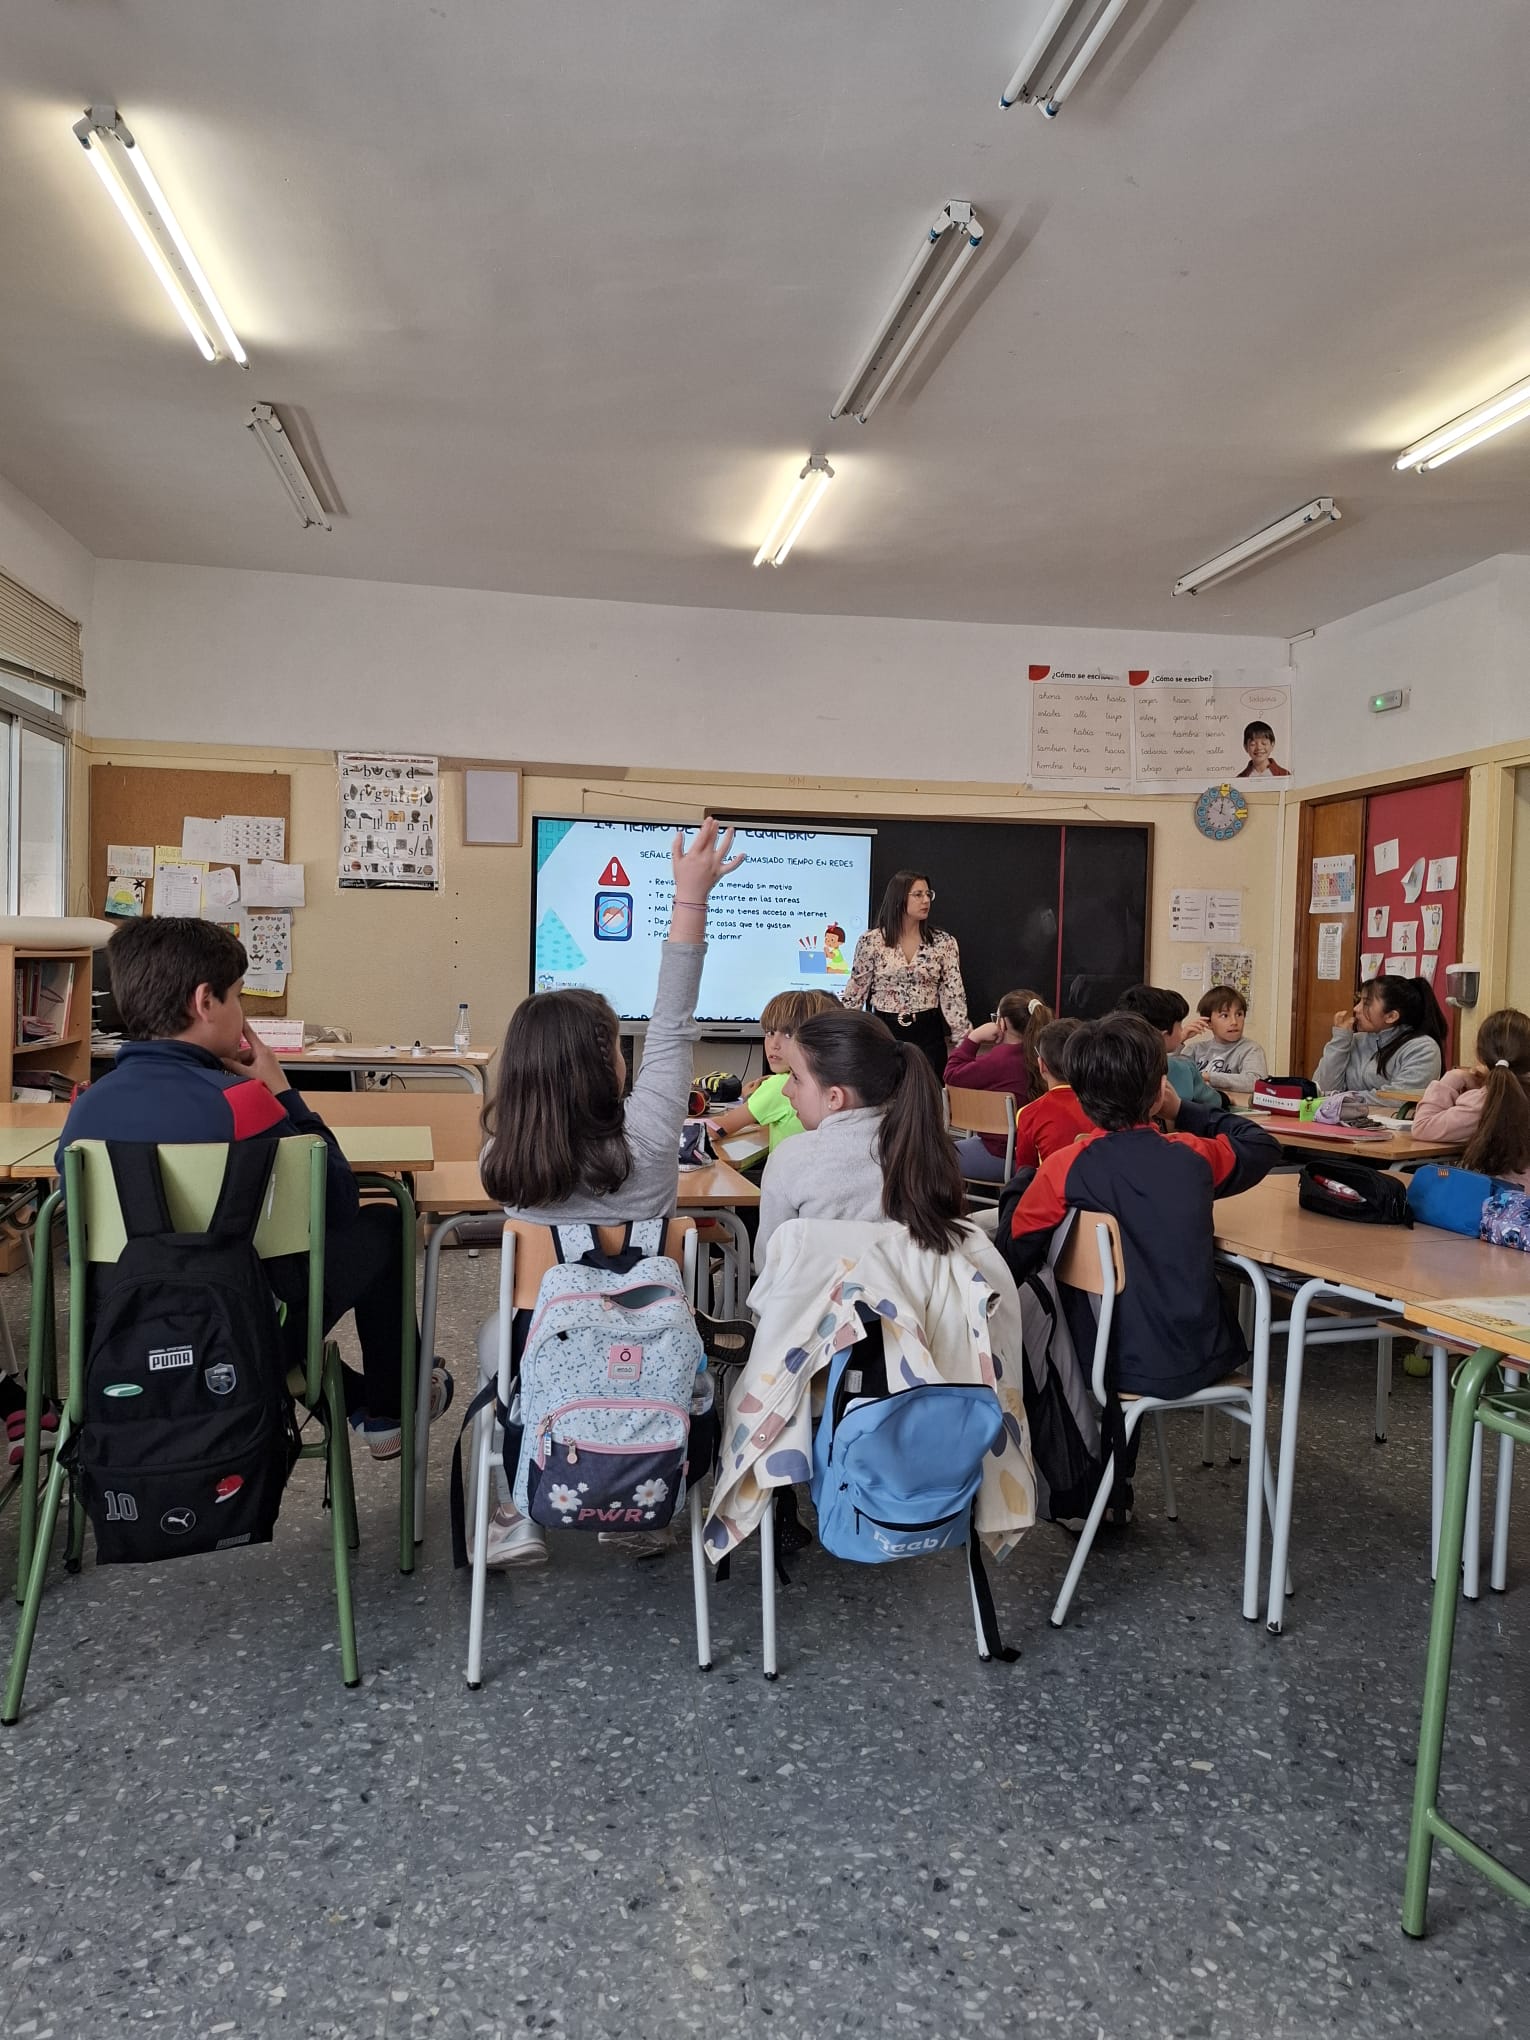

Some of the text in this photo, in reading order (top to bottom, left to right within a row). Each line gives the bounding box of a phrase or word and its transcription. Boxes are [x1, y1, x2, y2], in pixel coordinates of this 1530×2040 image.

[1052, 671, 1075, 679] ¿Cómo
[1152, 675, 1173, 683] ¿Cómo
[1183, 674, 1212, 682] escribe?
[342, 764, 414, 779] a b c d
[343, 793, 350, 801] e
[374, 790, 382, 802] g
[343, 816, 351, 829] k
[385, 822, 397, 830] m
[407, 823, 414, 831] n
[422, 820, 429, 832] ñ
[343, 845, 351, 854] o
[361, 846, 367, 857] p
[382, 846, 390, 858] q
[408, 847, 414, 855] s
[640, 850, 674, 860] SEÑALE
[744, 856, 784, 864] EMASIADO
[787, 857, 814, 866] TIEMPO
[816, 859, 827, 867] EN
[829, 860, 854, 868] REDES
[343, 864, 351, 872] u
[364, 864, 371, 872] v
[381, 865, 388, 873] x
[417, 866, 423, 874] z
[655, 878, 677, 886] Revis
[726, 881, 754, 889] menudo
[655, 891, 664, 899] Te
[738, 908, 760, 916] tienes
[797, 910, 828, 918] internet
[717, 932, 743, 940] dormir
[152, 1351, 191, 1369] PUMA
[104, 1490, 139, 1521] 10
[577, 1508, 644, 1522] PWR
[873, 1528, 953, 1557] Reeb
